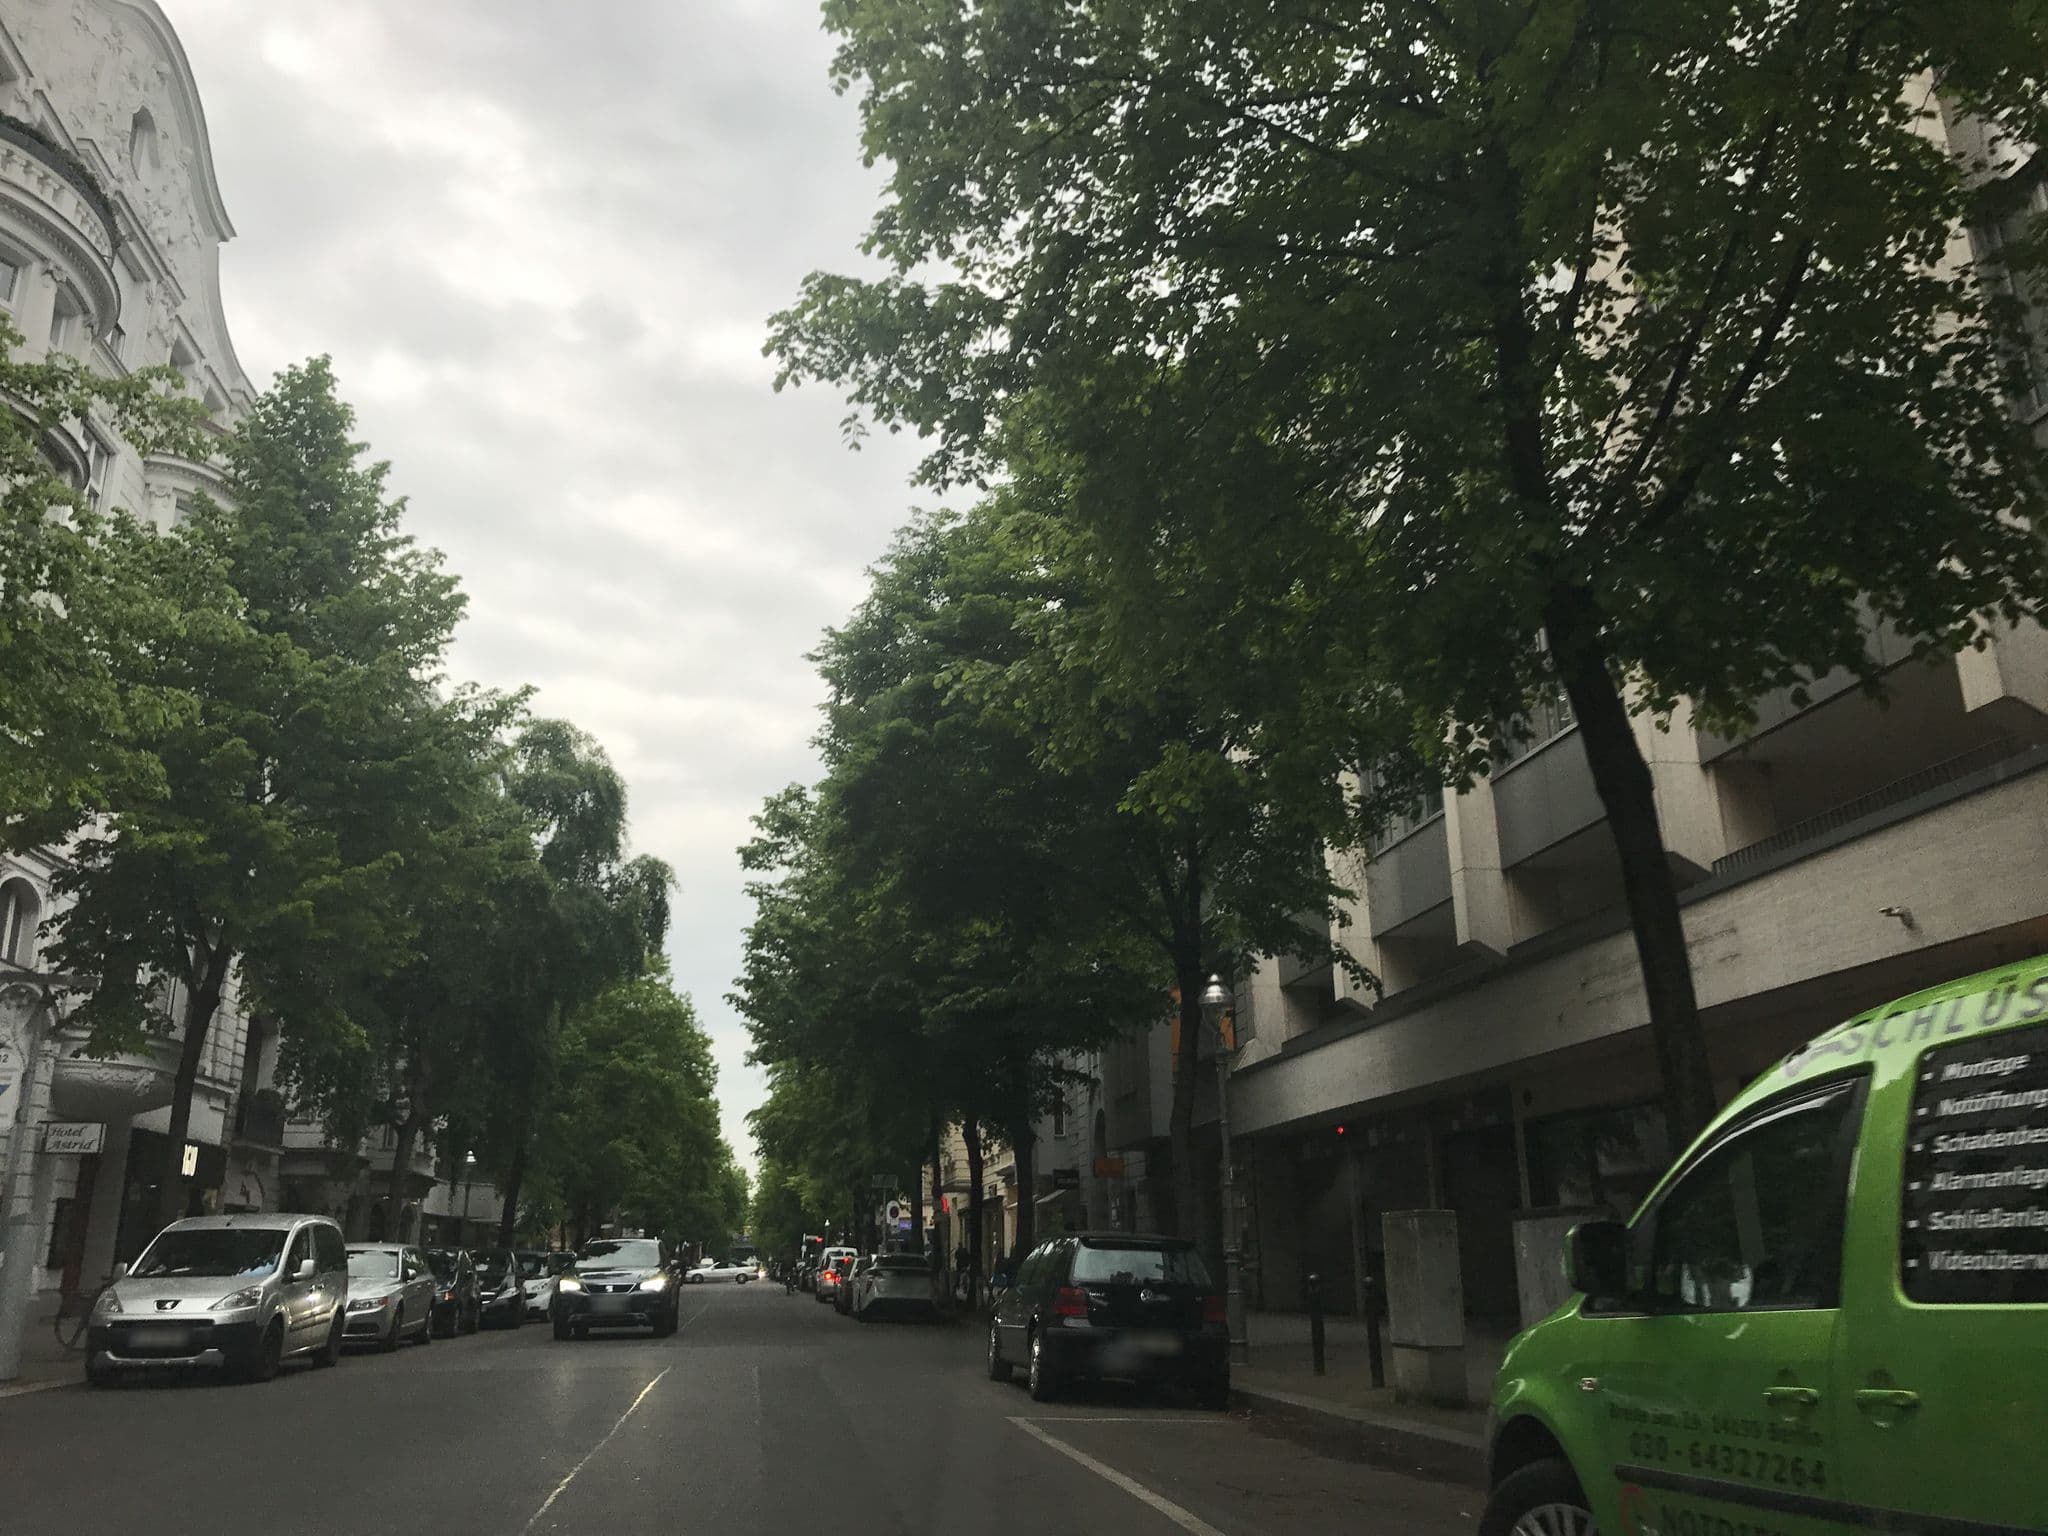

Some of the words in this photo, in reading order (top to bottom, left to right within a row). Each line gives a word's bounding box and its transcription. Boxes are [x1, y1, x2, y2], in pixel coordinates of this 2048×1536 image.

[1940, 1054, 2030, 1082] Montage
[51, 1127, 85, 1137] Hotel
[49, 1139, 94, 1150] Astrid
